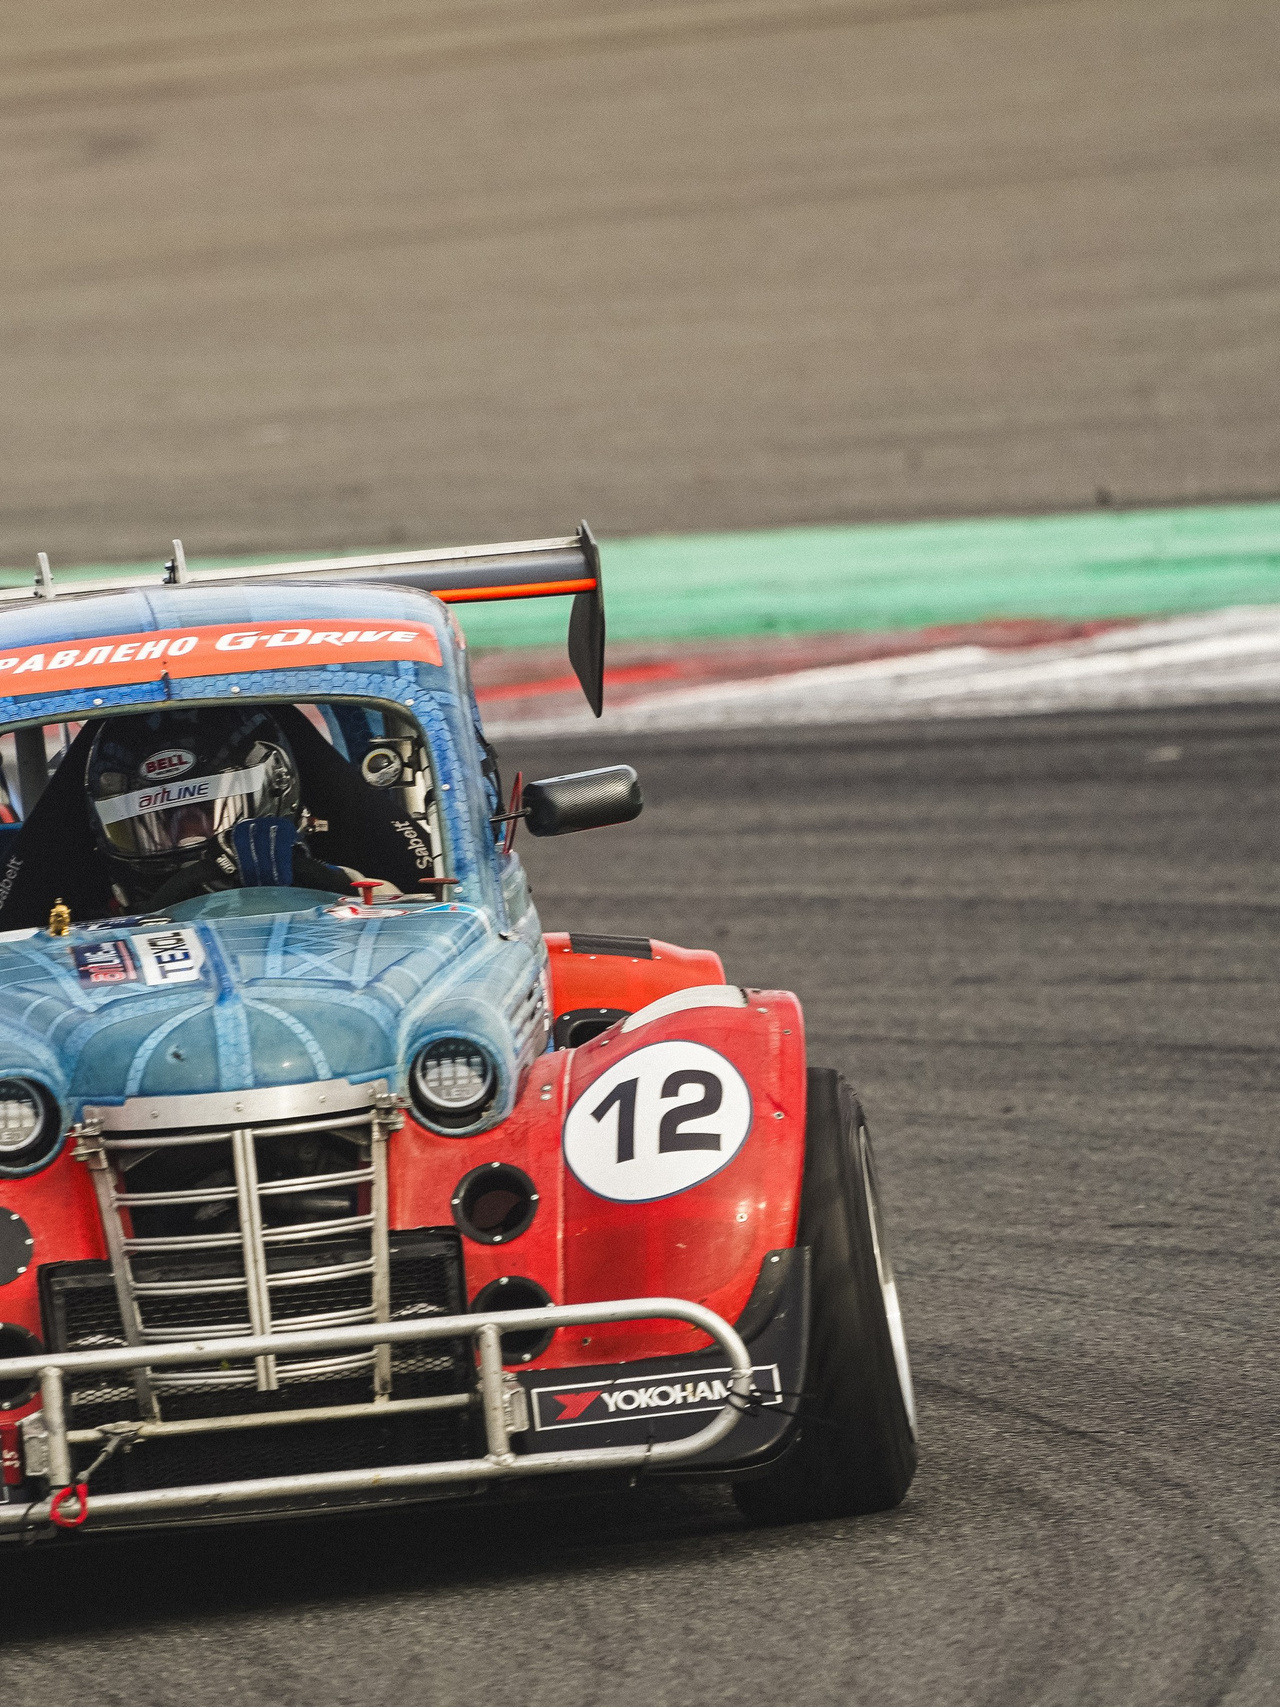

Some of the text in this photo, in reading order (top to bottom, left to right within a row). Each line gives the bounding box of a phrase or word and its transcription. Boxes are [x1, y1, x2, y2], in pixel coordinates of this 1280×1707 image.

[145, 754, 190, 775] BELL
[393, 820, 434, 870] Sabelt
[590, 1069, 723, 1164] 12
